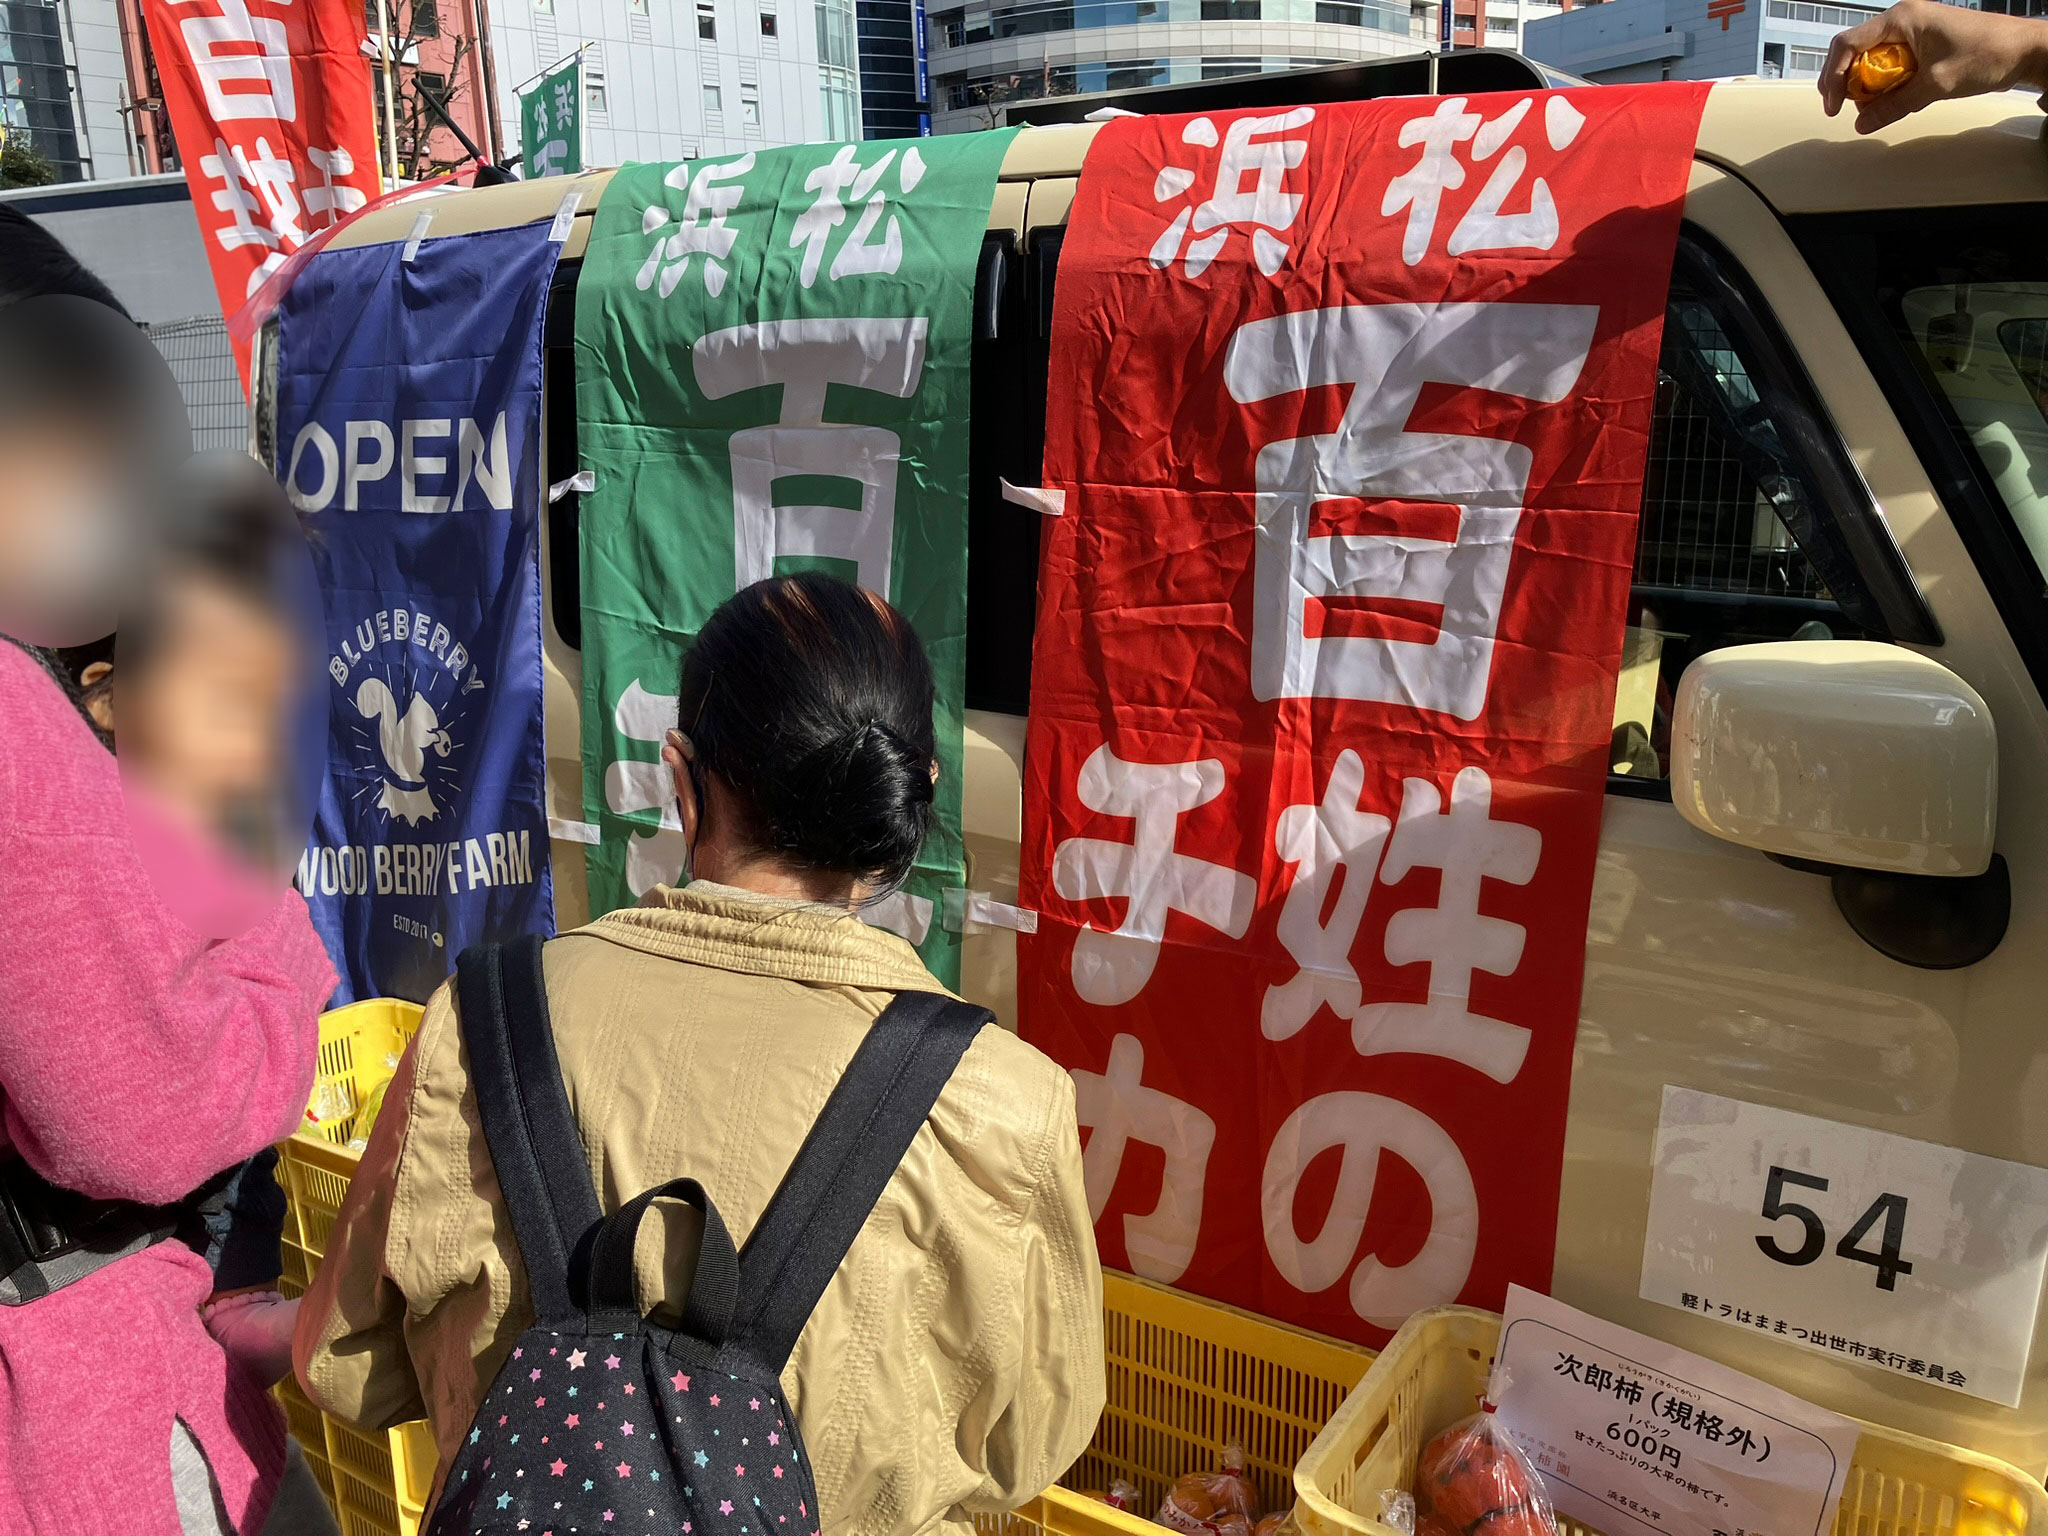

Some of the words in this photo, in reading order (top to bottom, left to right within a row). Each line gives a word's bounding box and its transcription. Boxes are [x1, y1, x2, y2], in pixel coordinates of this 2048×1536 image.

[635, 144, 927, 299] 浜松
[1149, 95, 1586, 279] 浜松
[286, 410, 513, 513] OPEN
[329, 608, 485, 696] BLUEBERRY
[298, 845, 368, 898] WOOD
[374, 842, 448, 896] BERRY
[447, 829, 533, 895] FARM
[1223, 302, 1600, 1330] 百姓の
[1754, 1165, 1912, 1292] 54
[1681, 1292, 1967, 1388] 軽トラはままつ出世市実行委員会
[1606, 1422, 1682, 1469] 600円
[1606, 1489, 1662, 1521] 浜名区大平
